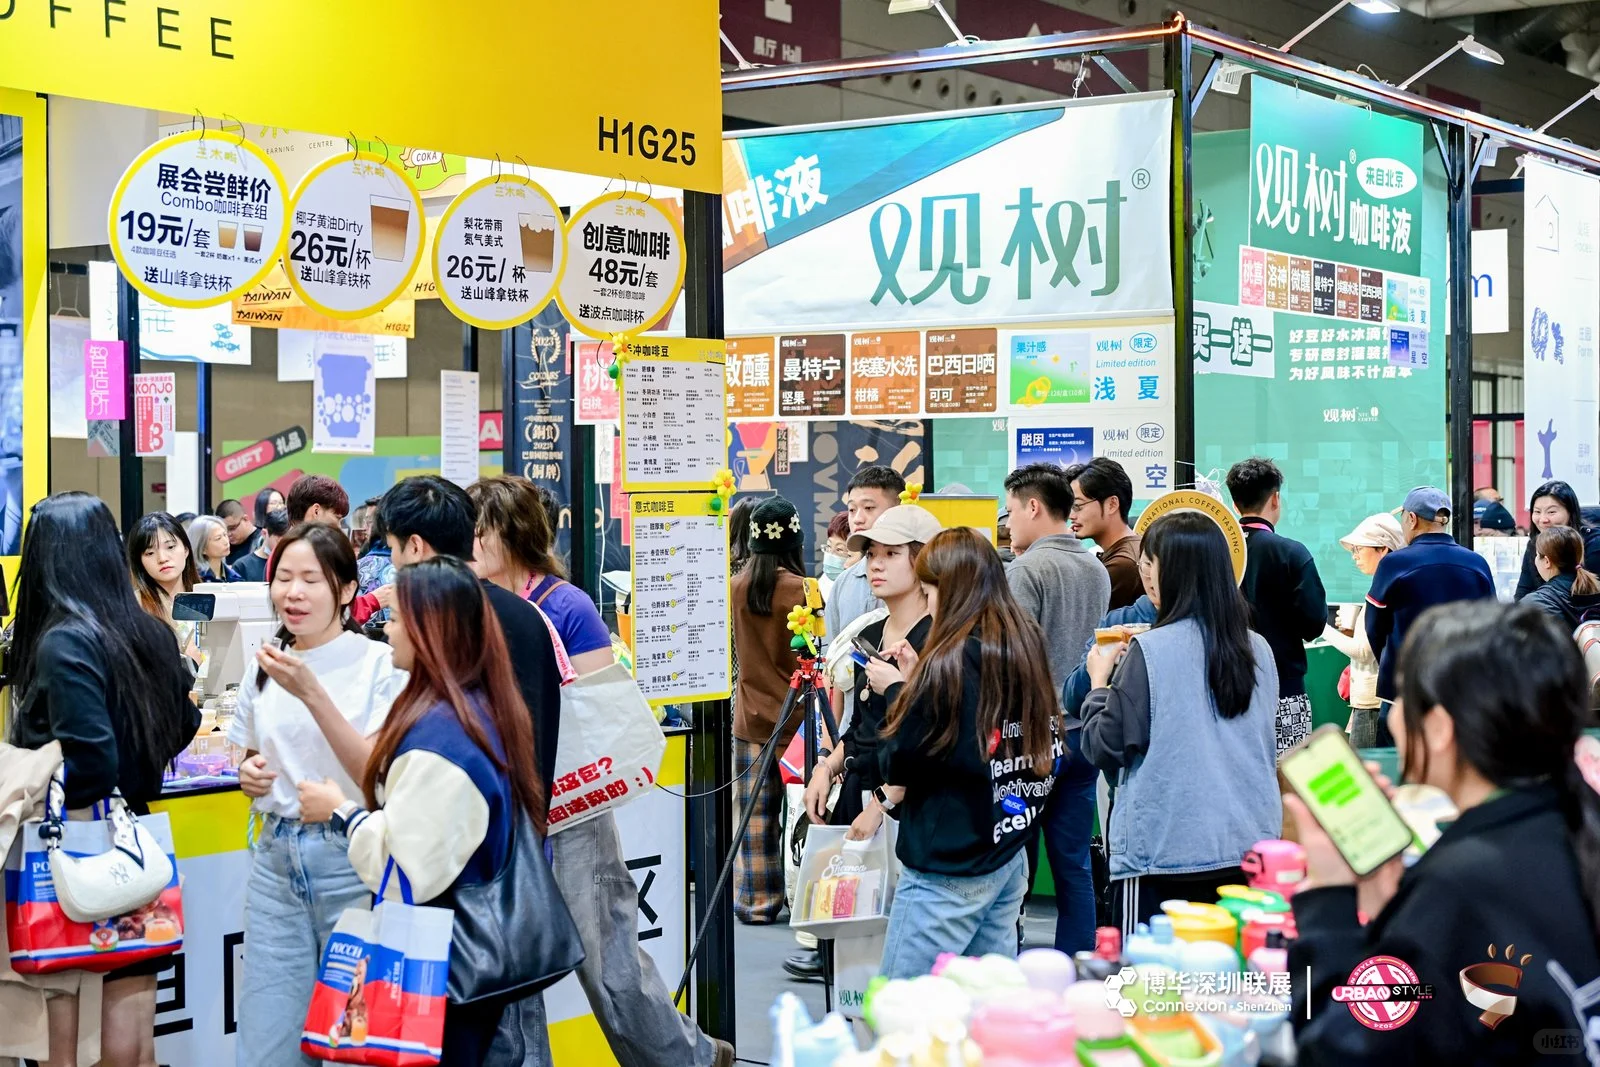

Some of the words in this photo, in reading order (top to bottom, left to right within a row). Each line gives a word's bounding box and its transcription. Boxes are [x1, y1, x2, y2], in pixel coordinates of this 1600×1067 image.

[308, 140, 333, 150] CENTRE
[598, 115, 697, 167] H1G25
[416, 152, 437, 162] COKA
[157, 163, 271, 204] 展会尝鲜价
[1365, 166, 1404, 189] 来自北京
[722, 154, 829, 248] 啡液
[1256, 142, 1349, 242] 观树
[161, 191, 268, 220] Combo咖啡套组
[120, 210, 211, 249] 19元/套
[296, 210, 363, 236] 椰子黄油Dirty
[464, 217, 503, 232] 梨花带雨
[1349, 198, 1412, 256] 咖啡液
[290, 230, 371, 270] 26元/杯
[464, 233, 504, 248] 氮气美式
[583, 221, 671, 260] 创意咖啡
[868, 179, 1128, 307] 观树
[144, 265, 233, 292] 送山峰拿铁杯
[301, 265, 371, 289] 送山峰拿铁杯
[589, 257, 659, 289] 48元/套
[243, 289, 292, 303] TAIWAN
[461, 286, 529, 303] 送山峰拿铁杯
[236, 309, 283, 322] TAIWAN
[579, 304, 645, 324] 送波点咖啡杯
[385, 322, 411, 332] H1G32
[1016, 341, 1047, 353] 果汁感
[1096, 339, 1123, 351] 观树
[1133, 337, 1154, 348] 限定
[1193, 311, 1273, 367] 买一送一
[627, 344, 669, 357] 冲咖啡豆
[783, 356, 841, 381] 曼特宁
[852, 355, 918, 377] 埃塞水洗
[927, 353, 995, 375] 巴西日晒
[1096, 359, 1126, 368] Limited
[1128, 359, 1156, 367] edition
[89, 345, 110, 416] 智造所
[582, 358, 619, 393] 桃
[782, 391, 805, 405] 坚果
[854, 387, 879, 402] 柑橘
[929, 387, 953, 401] 可可
[1323, 408, 1355, 422] 观树
[276, 431, 302, 454] 礼品
[1021, 433, 1045, 446] 脱因
[1102, 428, 1129, 441] 观树
[1140, 427, 1160, 439] 限定
[224, 447, 264, 474] GIFT
[1103, 448, 1132, 457] Limited
[1134, 448, 1163, 457] edition
[1145, 463, 1168, 489] 空
[635, 500, 674, 513] 意式咖啡豆
[1137, 497, 1185, 536] ERNATIONAL
[1189, 497, 1221, 516] COFFEE
[1222, 516, 1240, 554] TASTING
